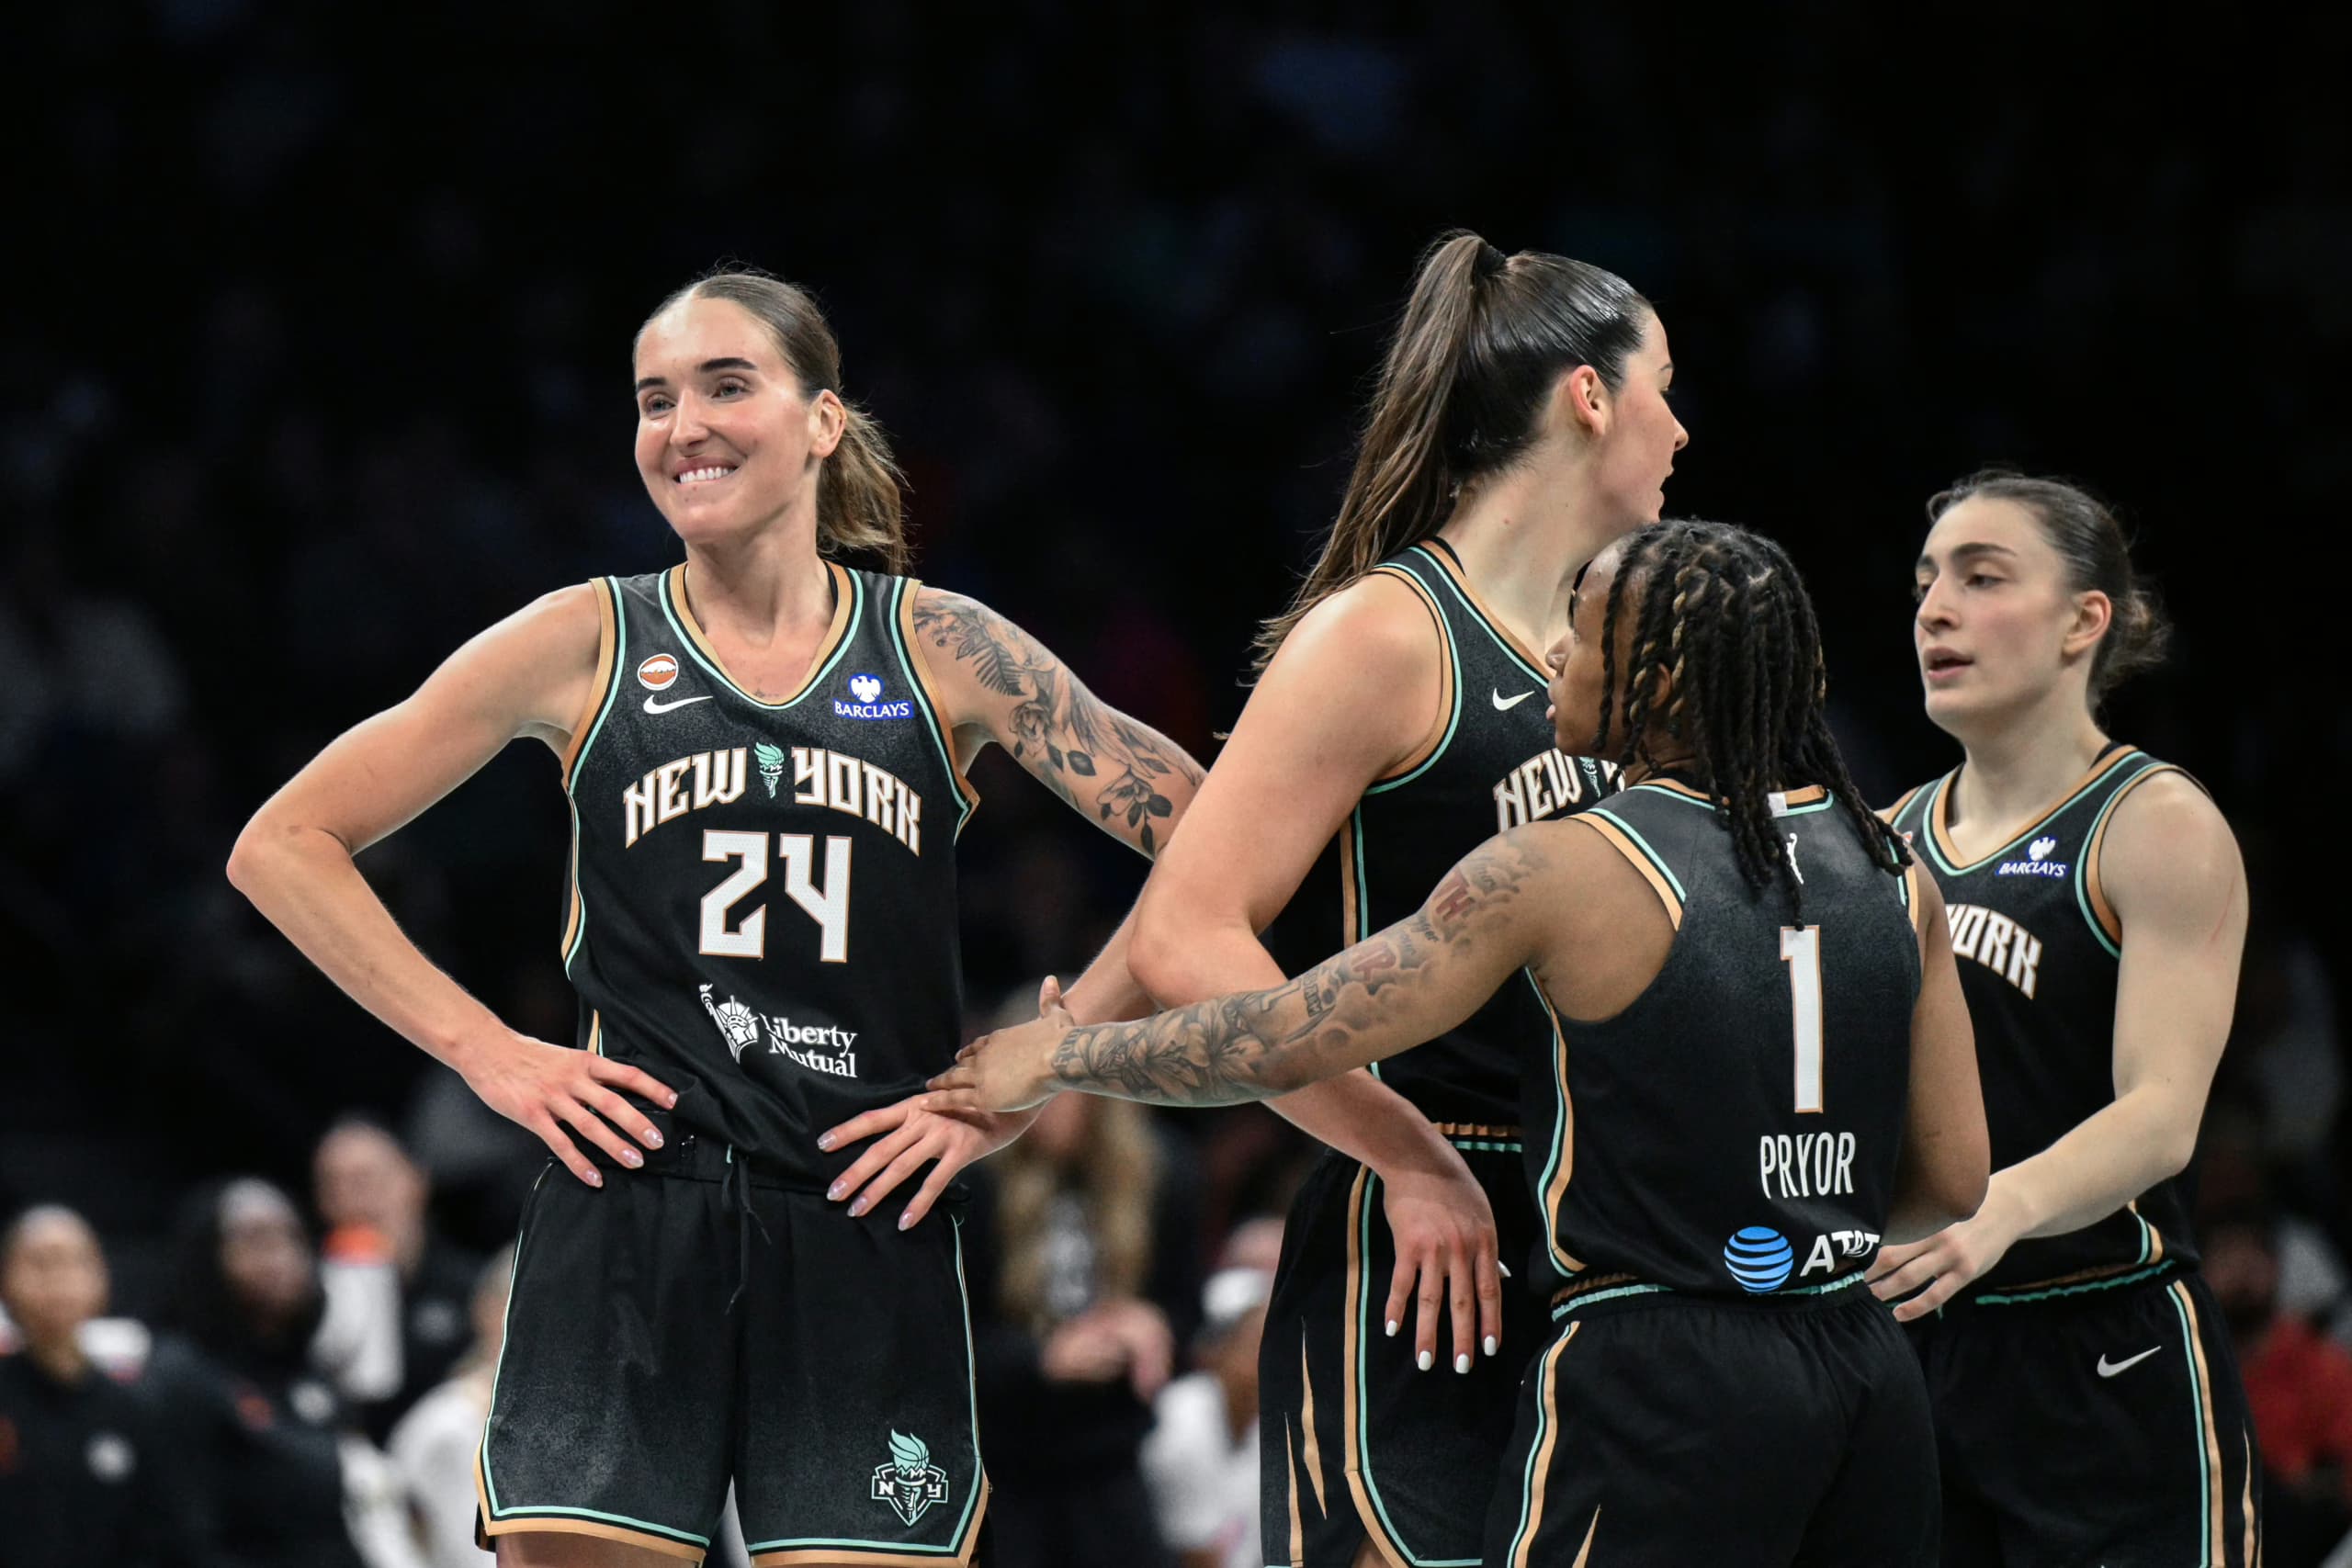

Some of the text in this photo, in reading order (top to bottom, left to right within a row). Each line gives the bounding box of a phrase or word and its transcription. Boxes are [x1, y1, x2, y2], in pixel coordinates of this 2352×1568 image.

[834, 700, 910, 718] BARCLAYS
[624, 747, 922, 858] NEW YORK
[1493, 748, 1583, 832] NEW
[698, 829, 853, 964] 24
[1998, 862, 2066, 878] BARCLAYS
[759, 1012, 858, 1057] Liberty
[1780, 924, 1824, 1114] 1
[768, 1032, 858, 1077] Mutual
[1760, 1132, 1857, 1201] PRYOR
